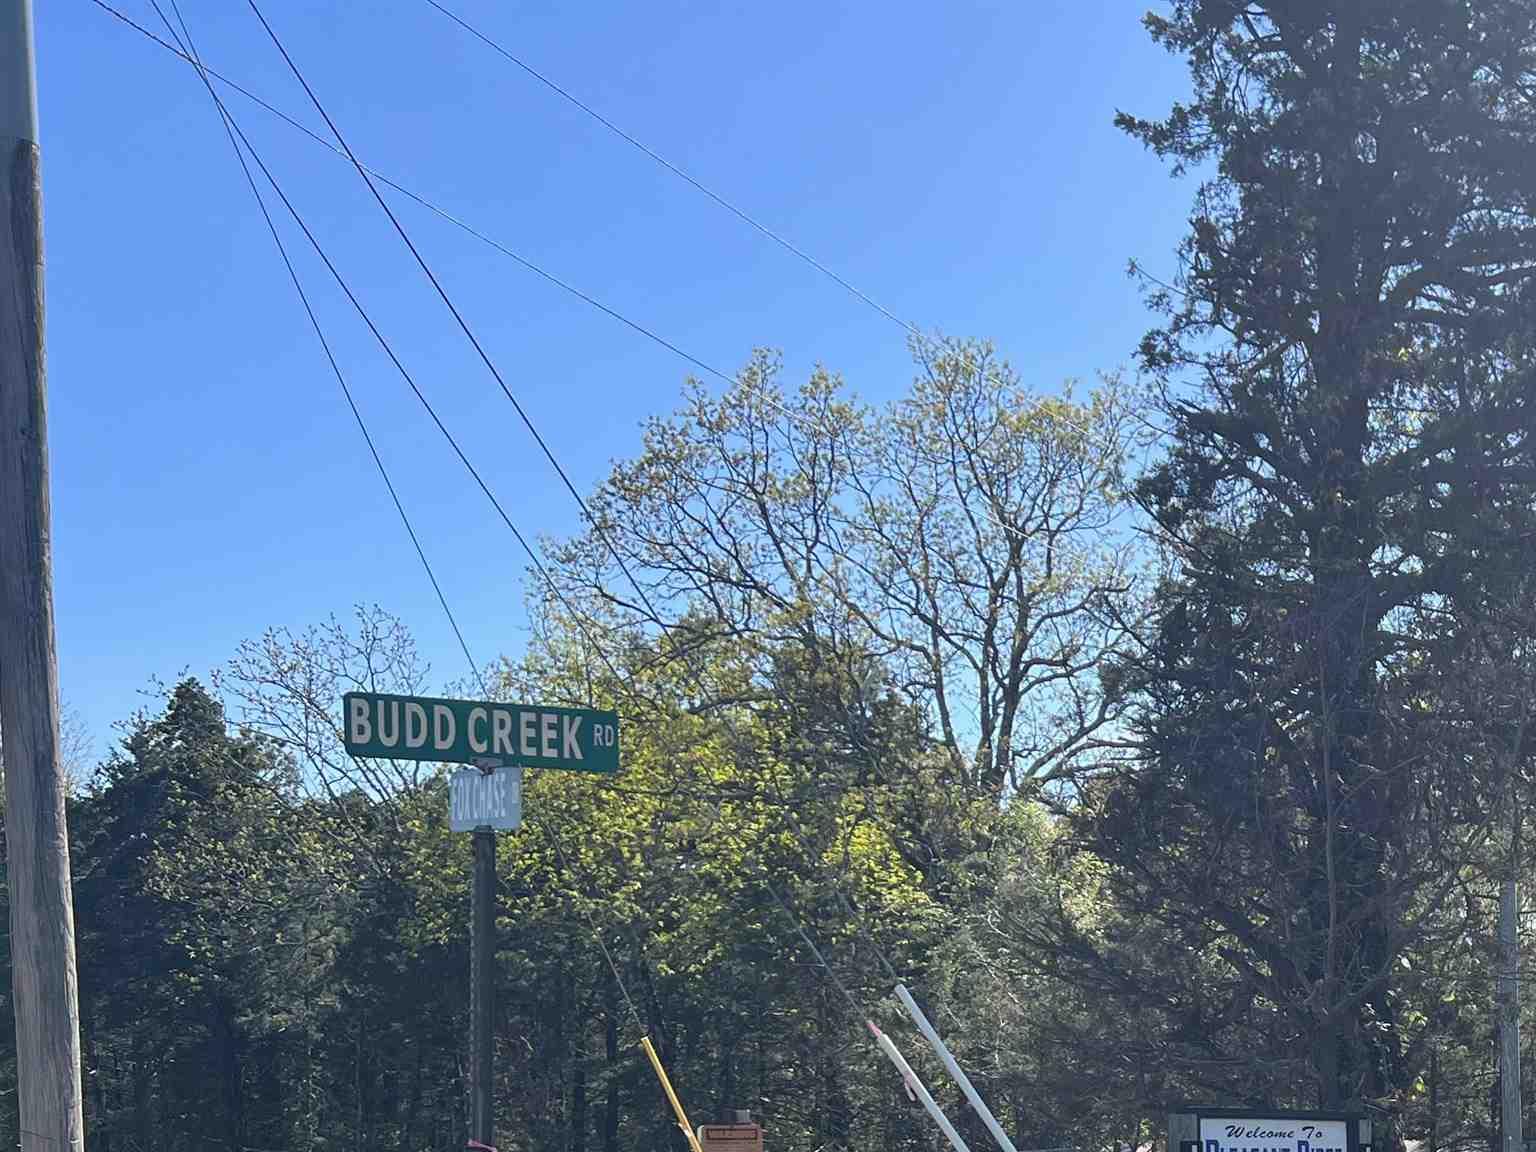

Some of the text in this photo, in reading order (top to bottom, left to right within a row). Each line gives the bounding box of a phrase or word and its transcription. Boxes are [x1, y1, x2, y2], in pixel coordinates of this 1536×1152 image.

[351, 699, 615, 760] BUDD CREEK RD
[1225, 1125, 1323, 1139] Welcome To
